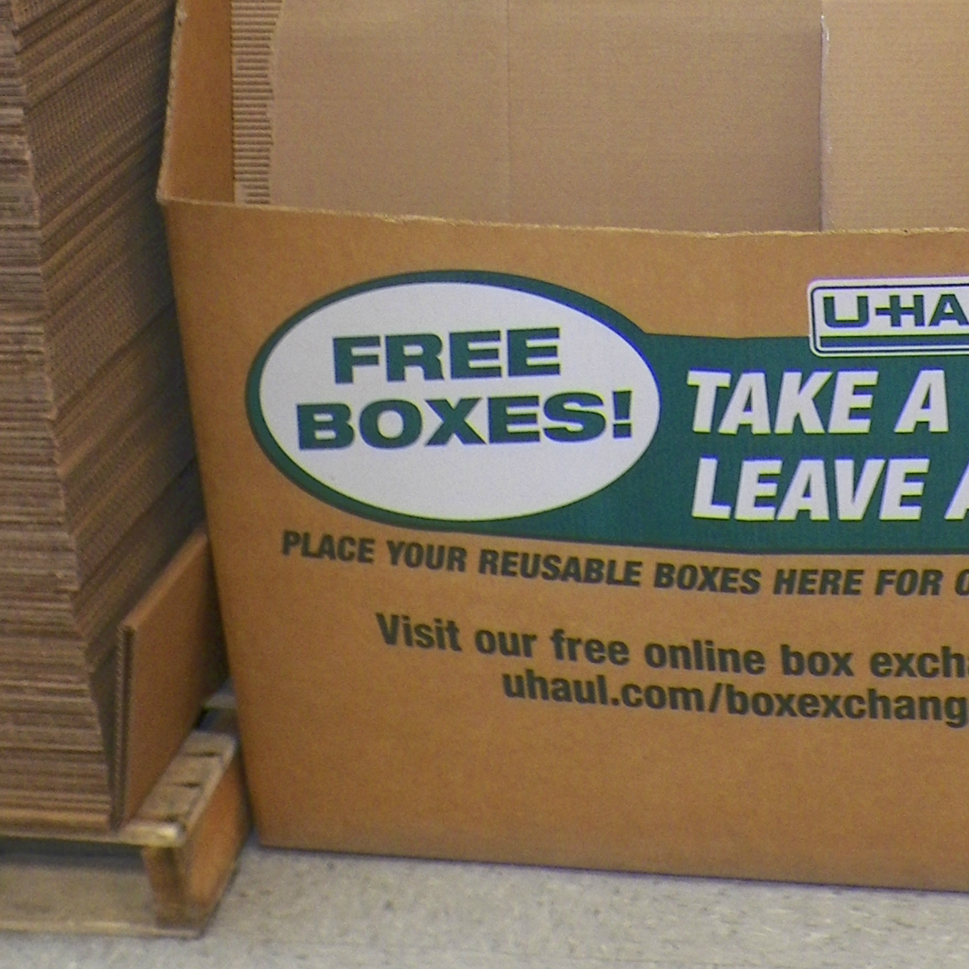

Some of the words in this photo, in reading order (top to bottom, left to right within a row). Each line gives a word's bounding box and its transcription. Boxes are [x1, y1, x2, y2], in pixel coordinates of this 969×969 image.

[333, 327, 560, 384] FREE
[296, 390, 632, 450] BOXES!
[687, 369, 879, 434] TAKE
[894, 368, 949, 433] A
[691, 457, 930, 521] LEAVE
[281, 530, 375, 564] PLACE
[386, 540, 467, 573] YOUR
[478, 549, 643, 587] REUSABLE
[653, 562, 761, 595] BOXES
[773, 568, 862, 596] HERE
[874, 568, 943, 596] FOR
[375, 612, 461, 652] Visit
[474, 628, 537, 658] our
[550, 628, 630, 666] free
[645, 639, 765, 676] online
[781, 644, 854, 678] box
